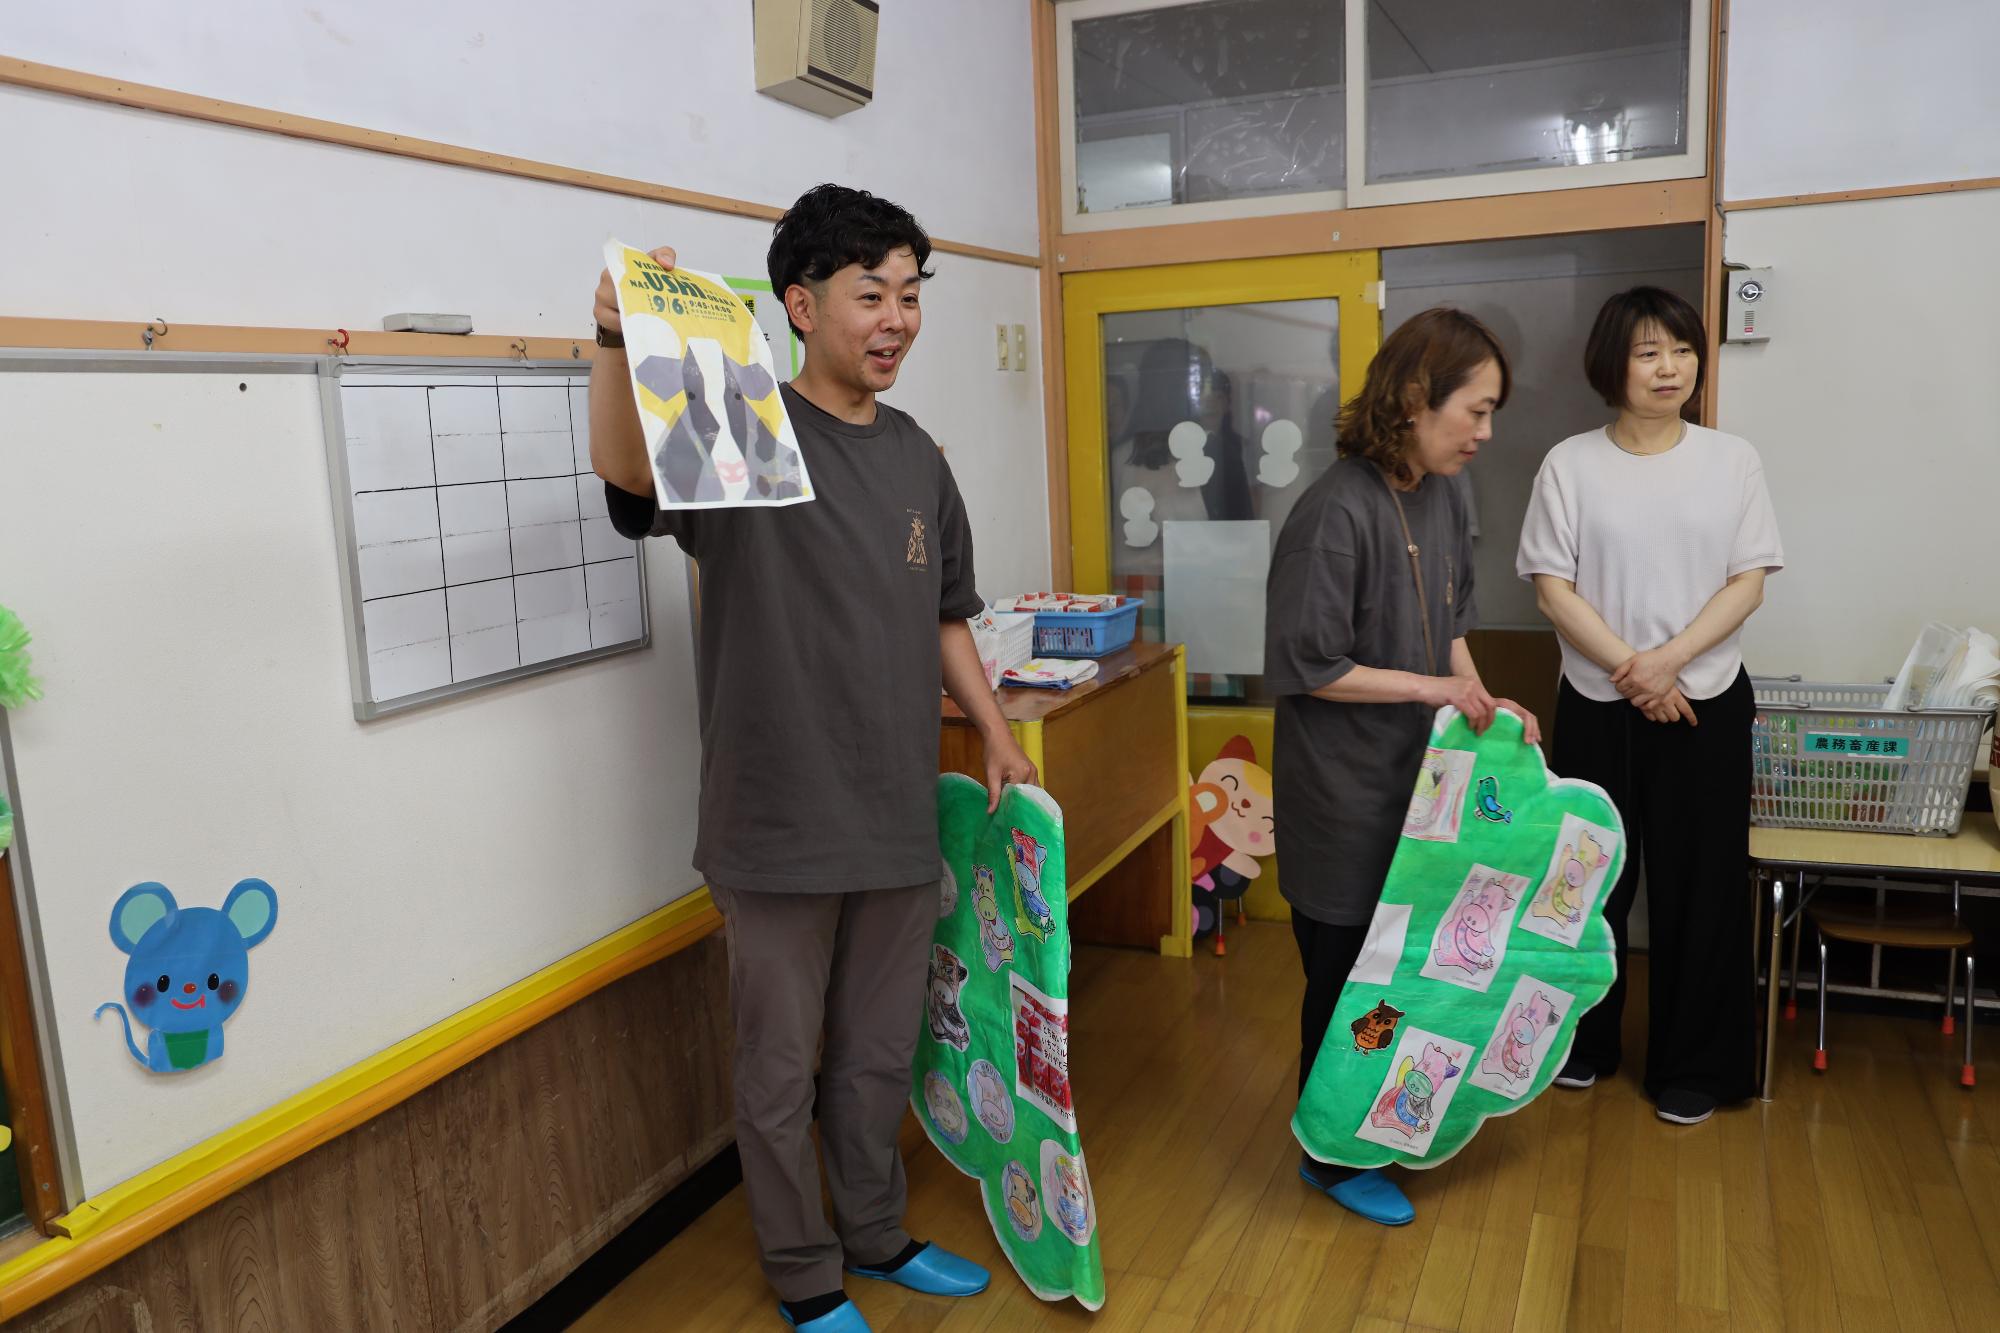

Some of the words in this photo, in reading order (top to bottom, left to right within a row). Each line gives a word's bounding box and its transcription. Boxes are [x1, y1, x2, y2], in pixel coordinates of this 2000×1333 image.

[642, 271, 707, 299] USHI
[1815, 737, 1898, 753] 農務畜産課
